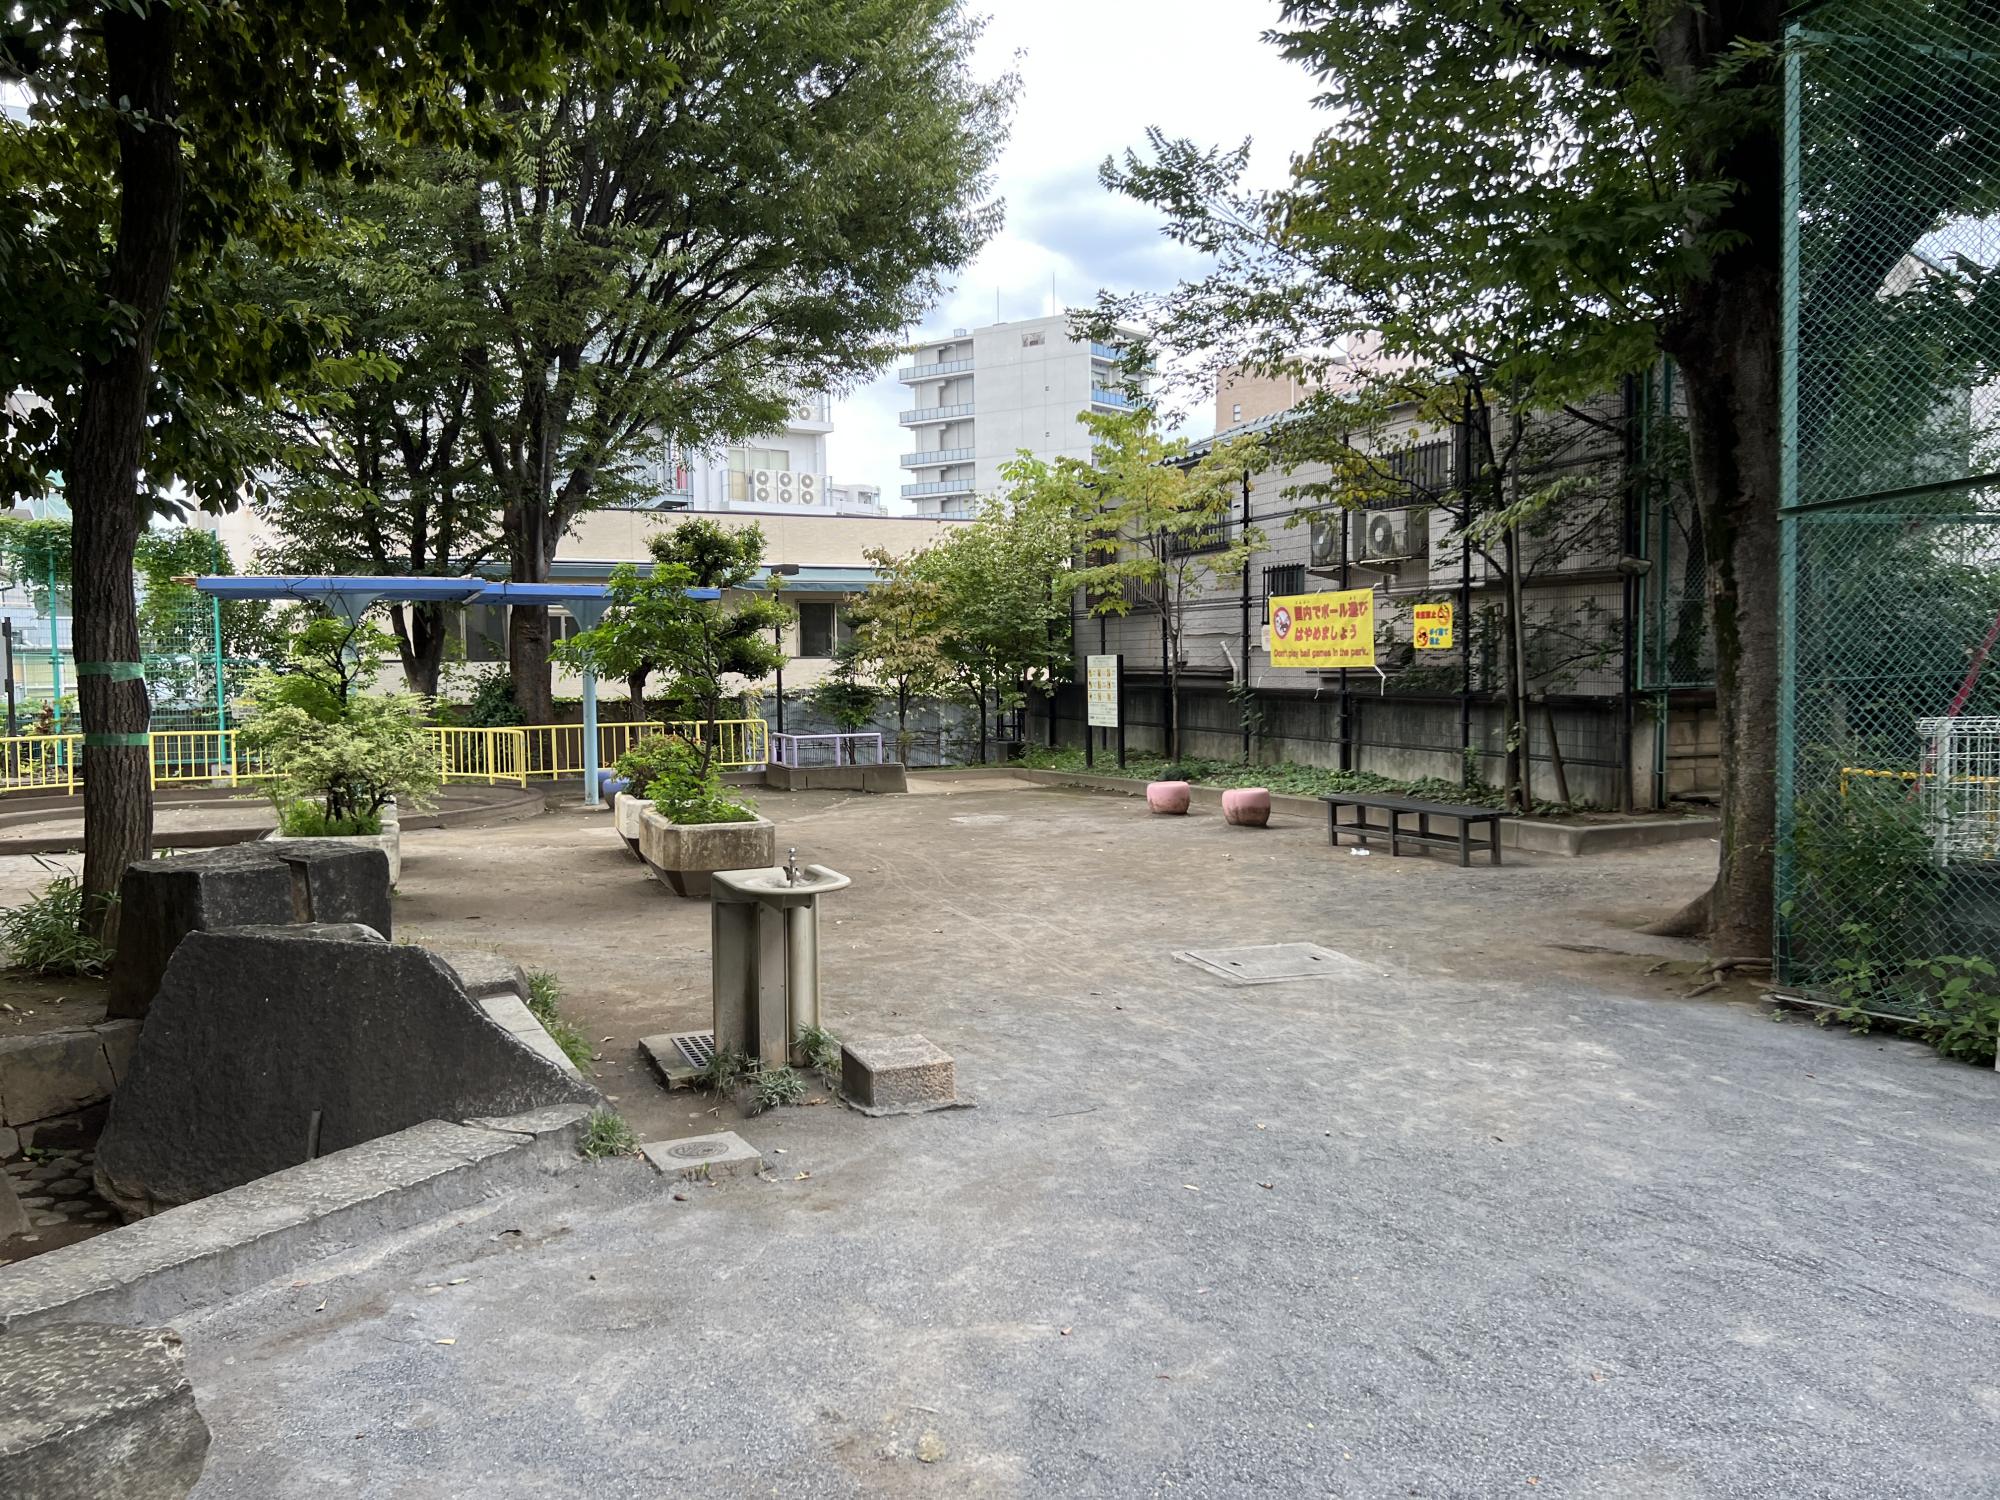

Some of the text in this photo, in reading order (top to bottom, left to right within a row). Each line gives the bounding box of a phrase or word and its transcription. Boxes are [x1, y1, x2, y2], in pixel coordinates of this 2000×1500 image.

[1295, 624, 1357, 641] はやめましょう
[1300, 648, 1310, 657] ball
[1312, 649, 1331, 659] games
[1333, 648, 1338, 657] in
[1340, 648, 1349, 656] the
